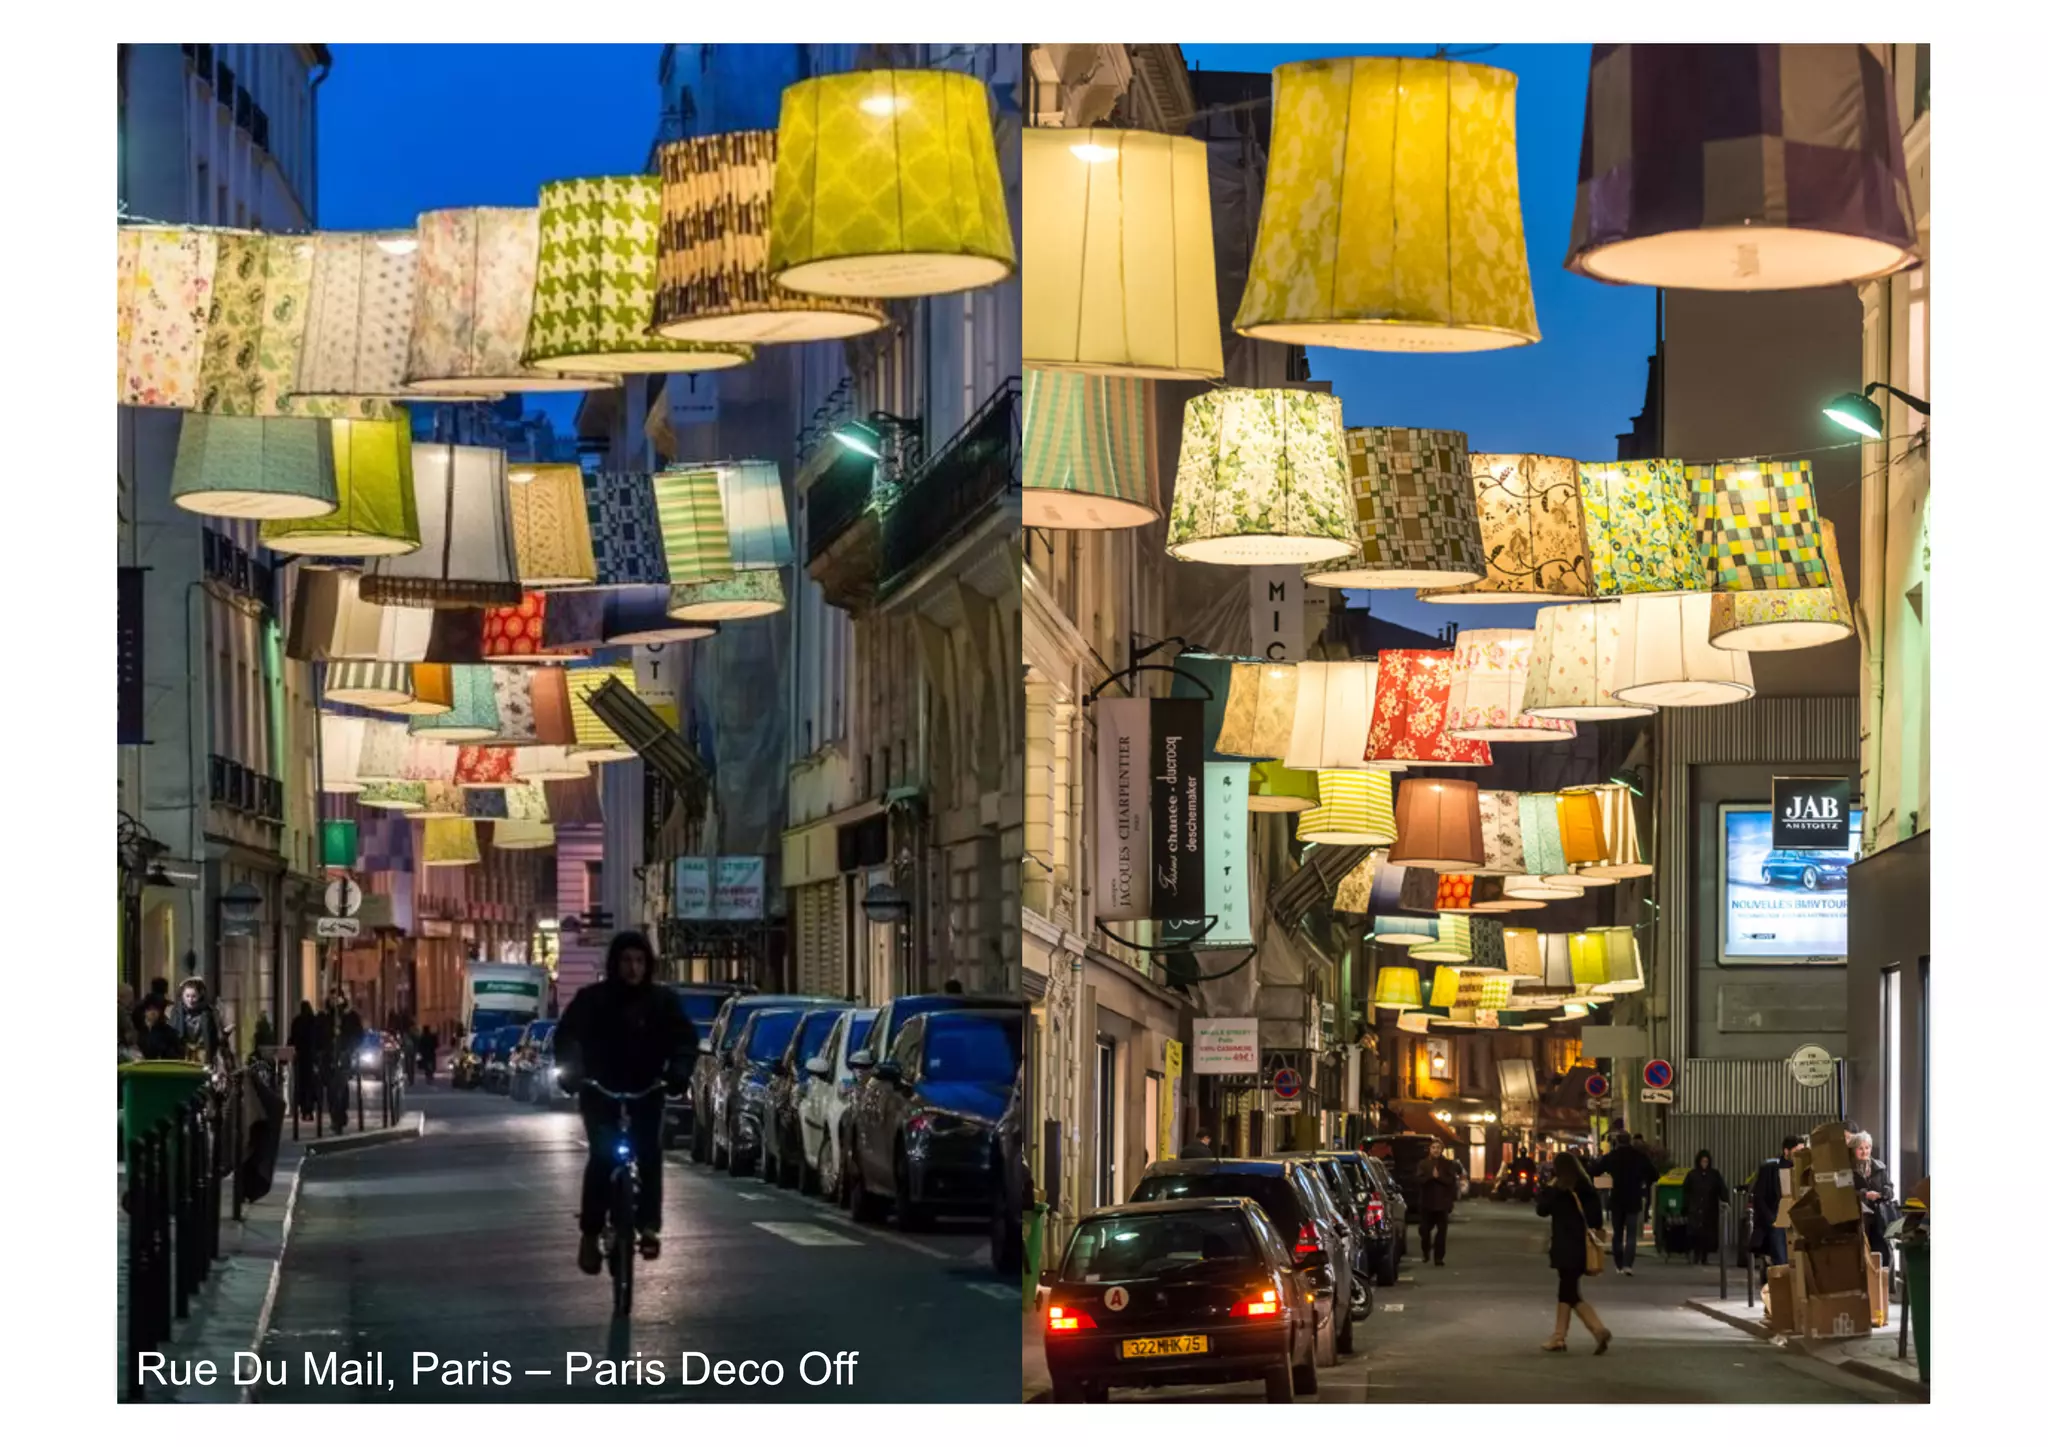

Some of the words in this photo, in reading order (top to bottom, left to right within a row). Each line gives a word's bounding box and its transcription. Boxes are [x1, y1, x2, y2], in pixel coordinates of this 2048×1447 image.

[1156, 735, 1183, 785] ducrocq
[1118, 735, 1132, 841] CHARPENTIER
[1785, 795, 1839, 819] JAB
[1185, 775, 1198, 853] deschemaker
[1119, 847, 1133, 908] JACQUES
[1731, 899, 1793, 909] NOUVELLES
[1110, 1290, 1122, 1306] A
